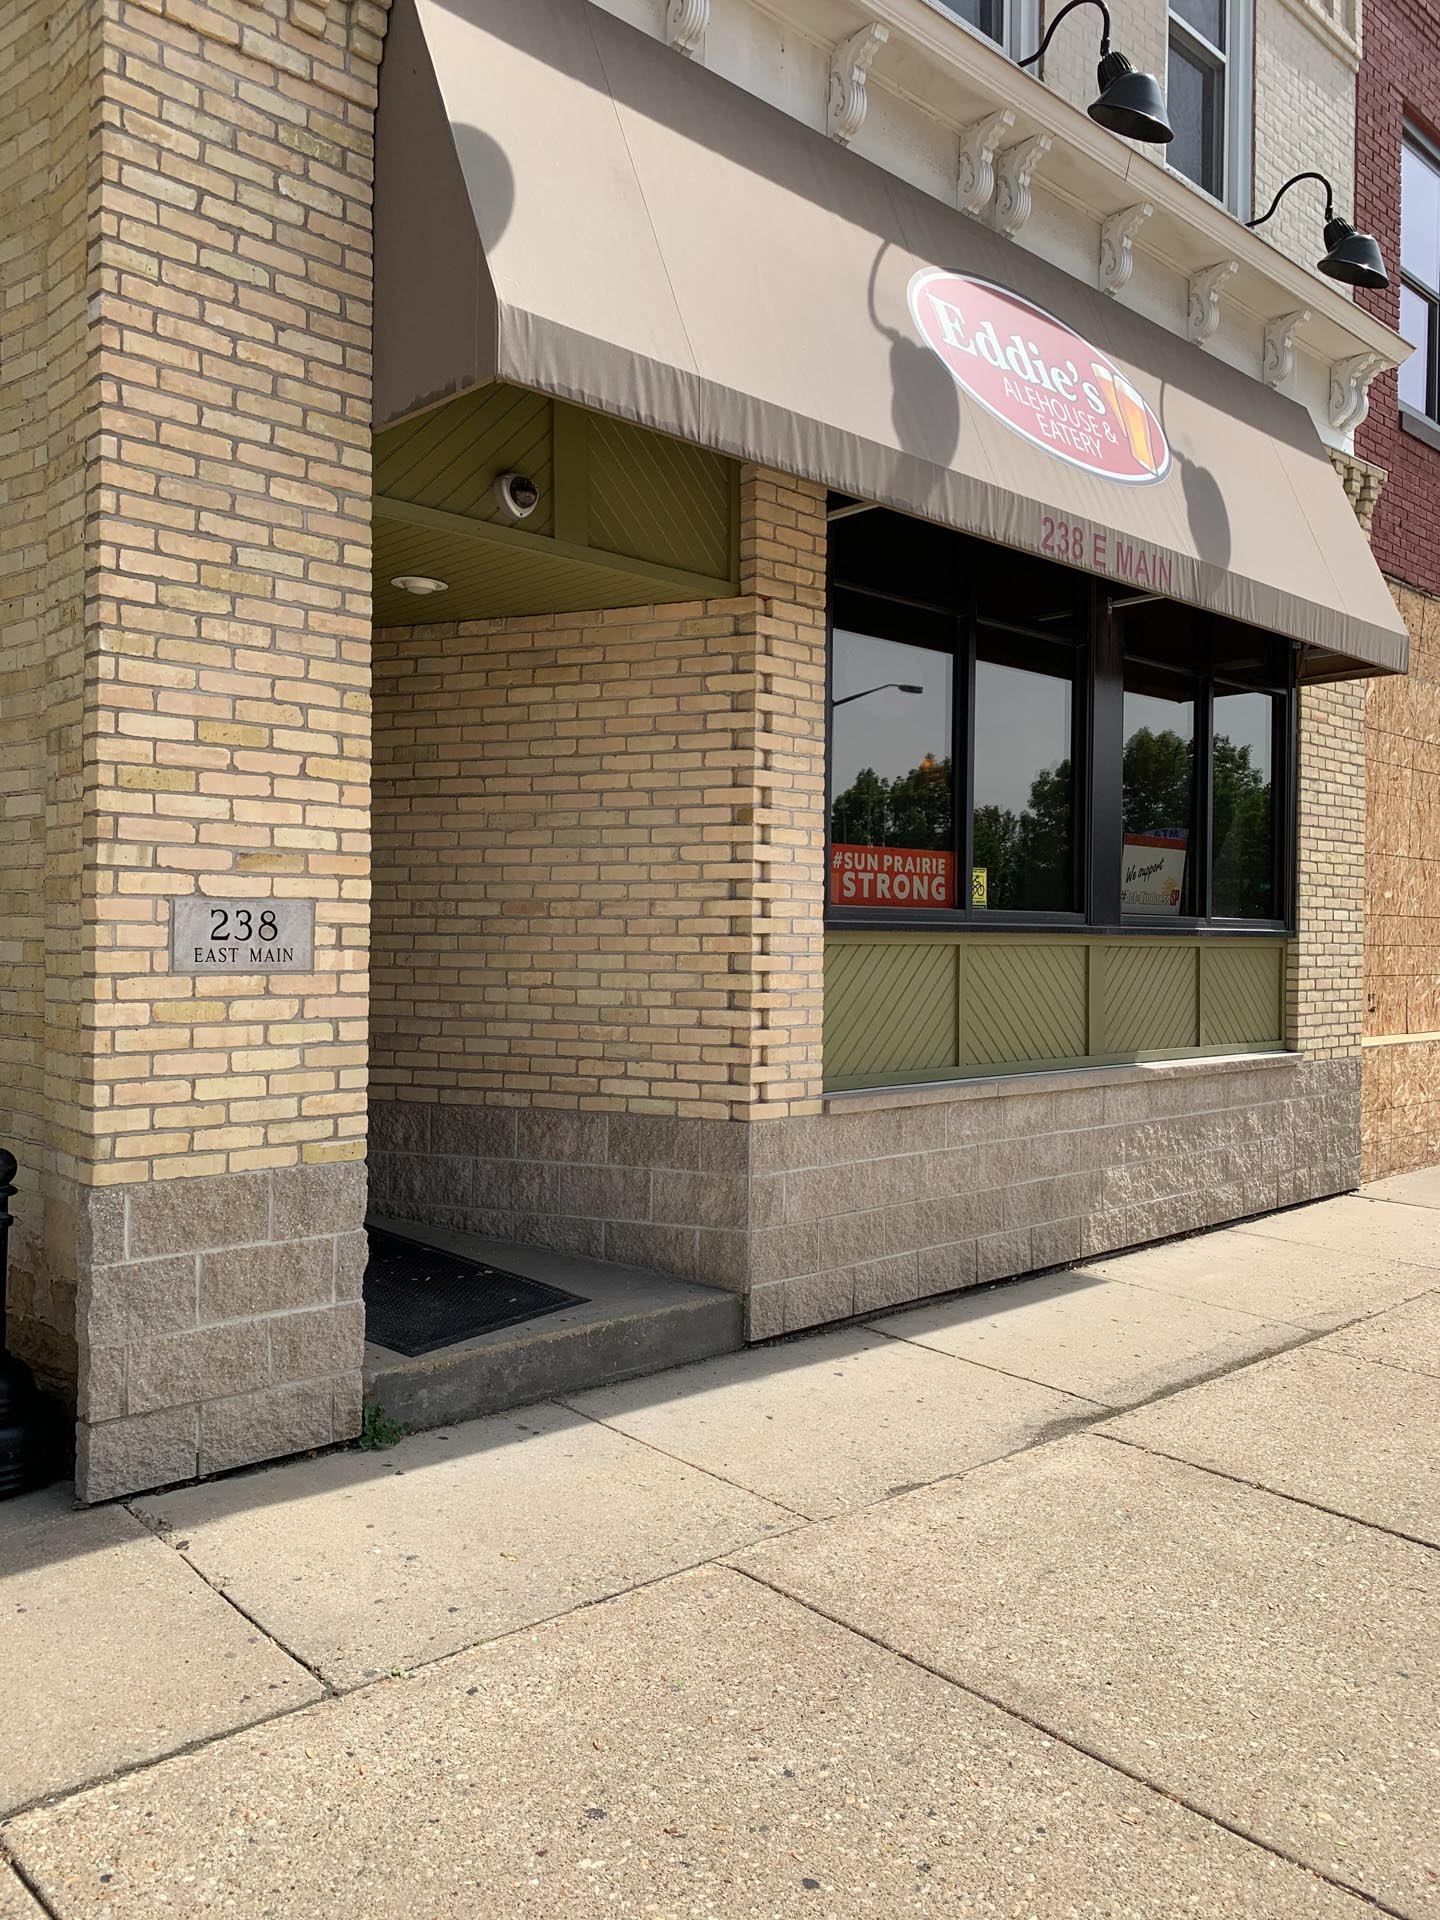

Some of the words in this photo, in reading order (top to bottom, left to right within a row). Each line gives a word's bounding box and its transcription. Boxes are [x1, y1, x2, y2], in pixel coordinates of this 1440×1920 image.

[925, 291, 1107, 415] Eddie's
[1002, 376, 1103, 440] ALEHOUSE
[1102, 420, 1120, 446] &
[1035, 411, 1104, 460] EATERY
[1041, 516, 1084, 561] 238
[1092, 532, 1107, 568] E
[1115, 540, 1173, 590] MAIN
[1154, 829, 1179, 838] ATM
[833, 851, 879, 871] #SUN
[883, 854, 946, 875] PRAIRIE
[1125, 864, 1136, 883] We
[1137, 857, 1165, 882] support
[842, 871, 946, 900] STRONG
[210, 908, 279, 942] 238
[194, 947, 239, 963] EAST
[249, 947, 294, 963] MAIN
